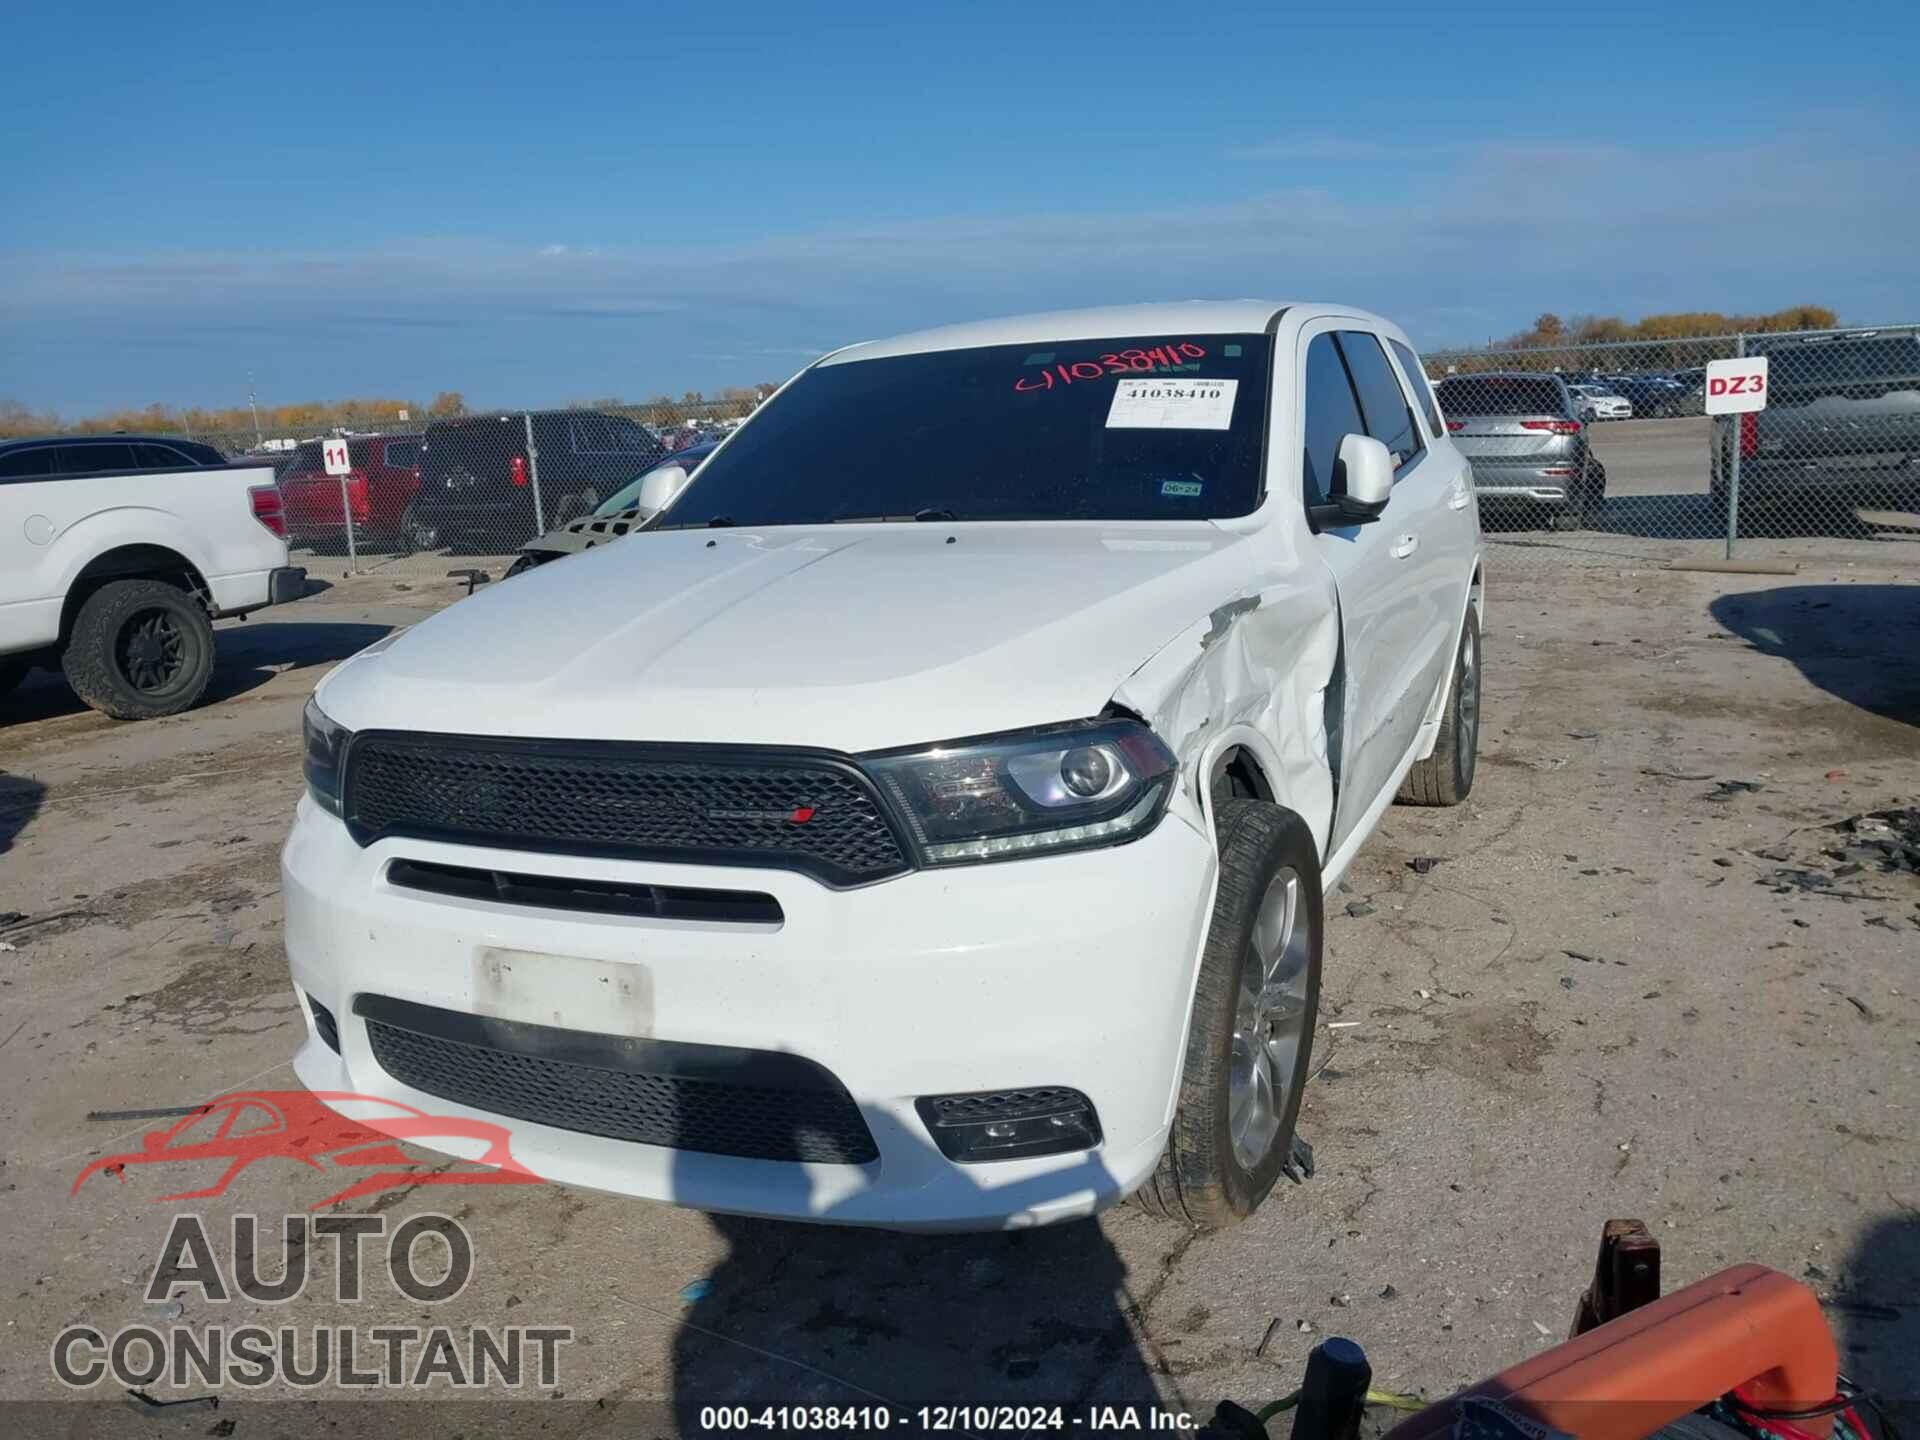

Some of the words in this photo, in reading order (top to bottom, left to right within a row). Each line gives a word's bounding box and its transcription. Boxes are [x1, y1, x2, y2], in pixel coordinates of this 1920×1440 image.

[1015, 343, 1206, 391] 41038410
[1127, 388, 1221, 399] 41038410
[1709, 375, 1764, 396] DZ3
[326, 447, 346, 466] 11
